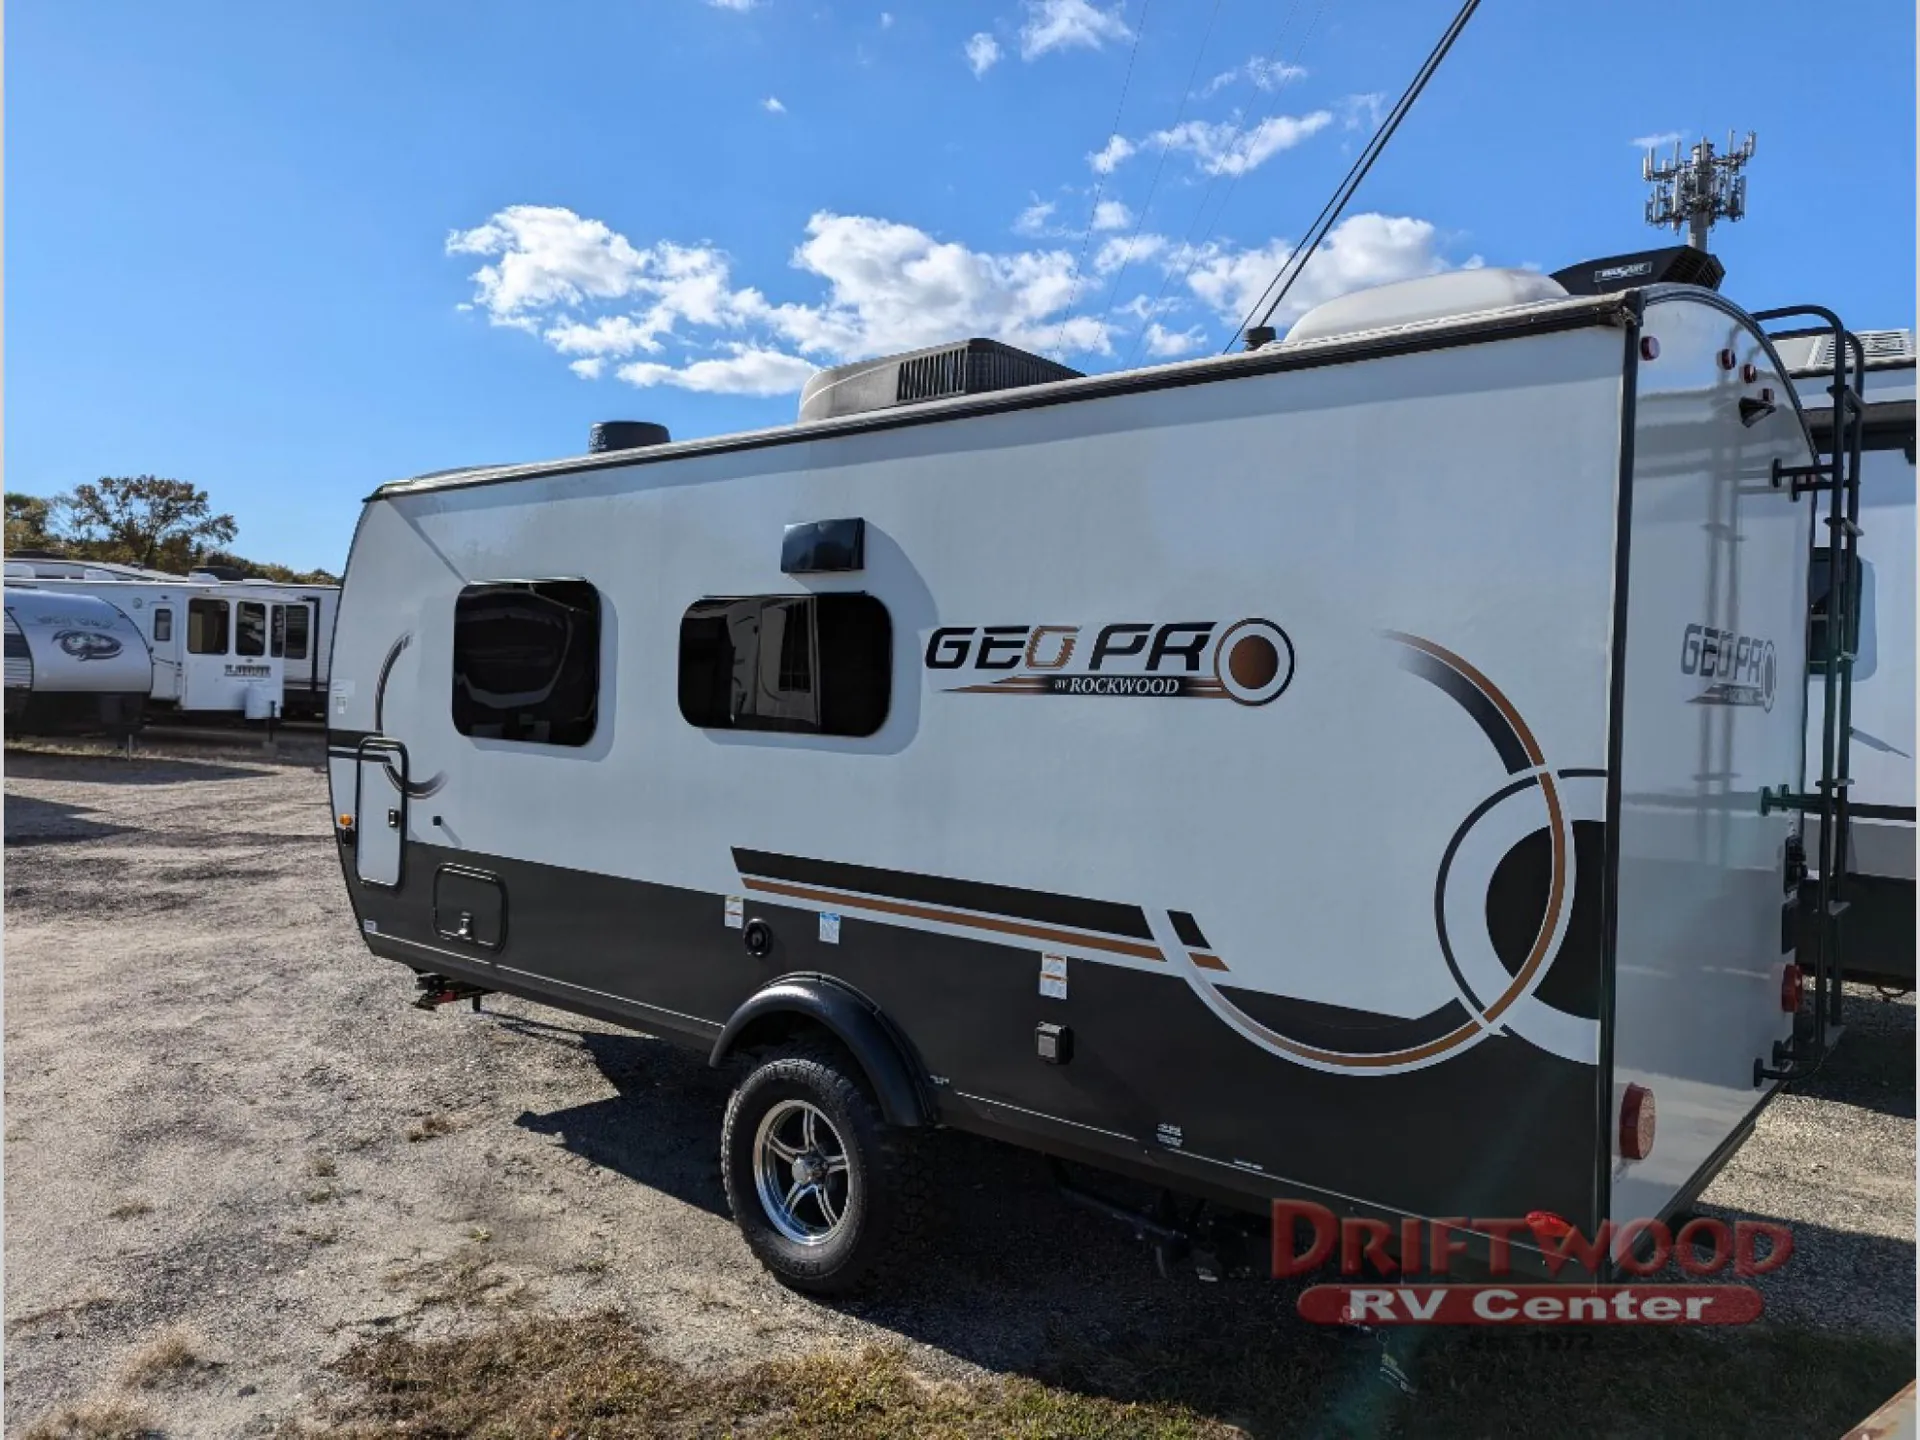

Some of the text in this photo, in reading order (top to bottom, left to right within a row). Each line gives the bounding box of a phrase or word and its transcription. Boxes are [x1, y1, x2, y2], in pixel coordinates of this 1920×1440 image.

[925, 625, 1080, 671] GEO
[1681, 623, 1734, 677] GEO
[1069, 677, 1180, 695] ROCKWOOD
